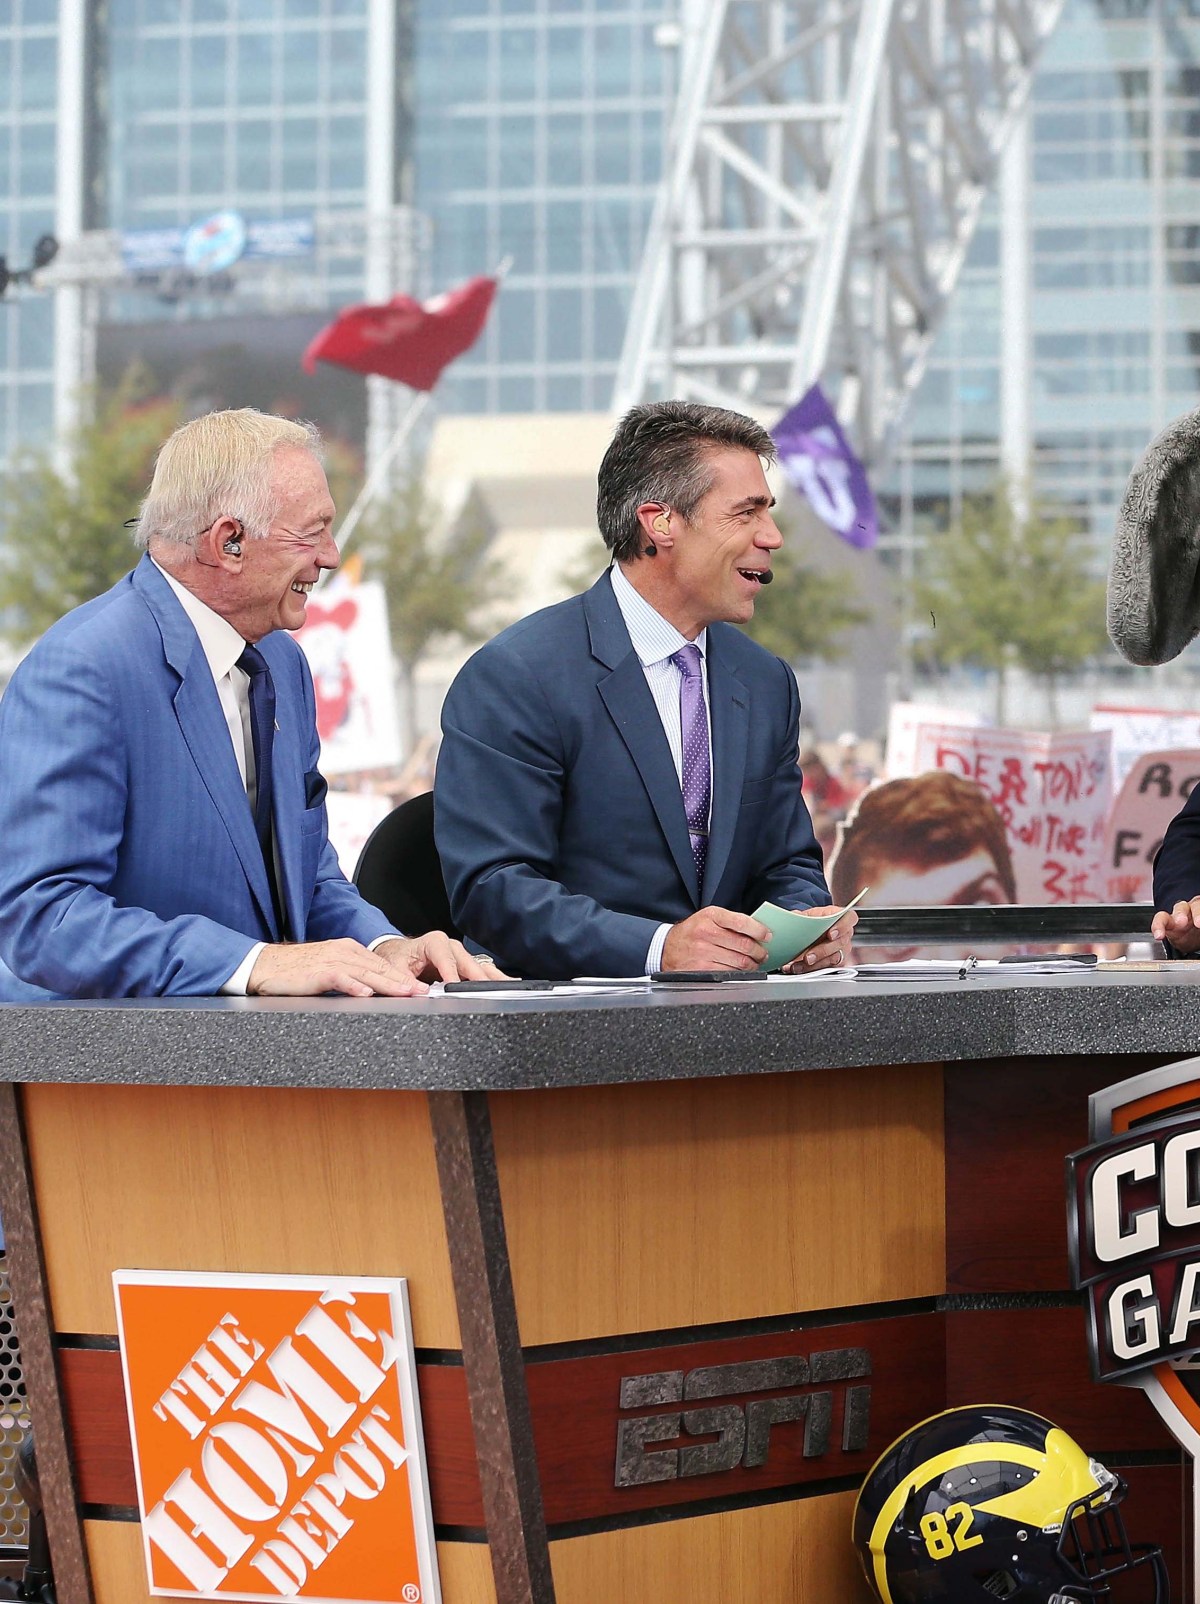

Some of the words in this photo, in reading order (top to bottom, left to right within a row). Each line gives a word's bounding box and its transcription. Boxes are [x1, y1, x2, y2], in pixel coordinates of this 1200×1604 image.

[144, 1288, 399, 1593] HOME
[153, 1311, 266, 1440] THE
[614, 1347, 873, 1488] ESPN
[249, 1404, 411, 1597] DEPOT
[919, 1501, 984, 1561] 82
